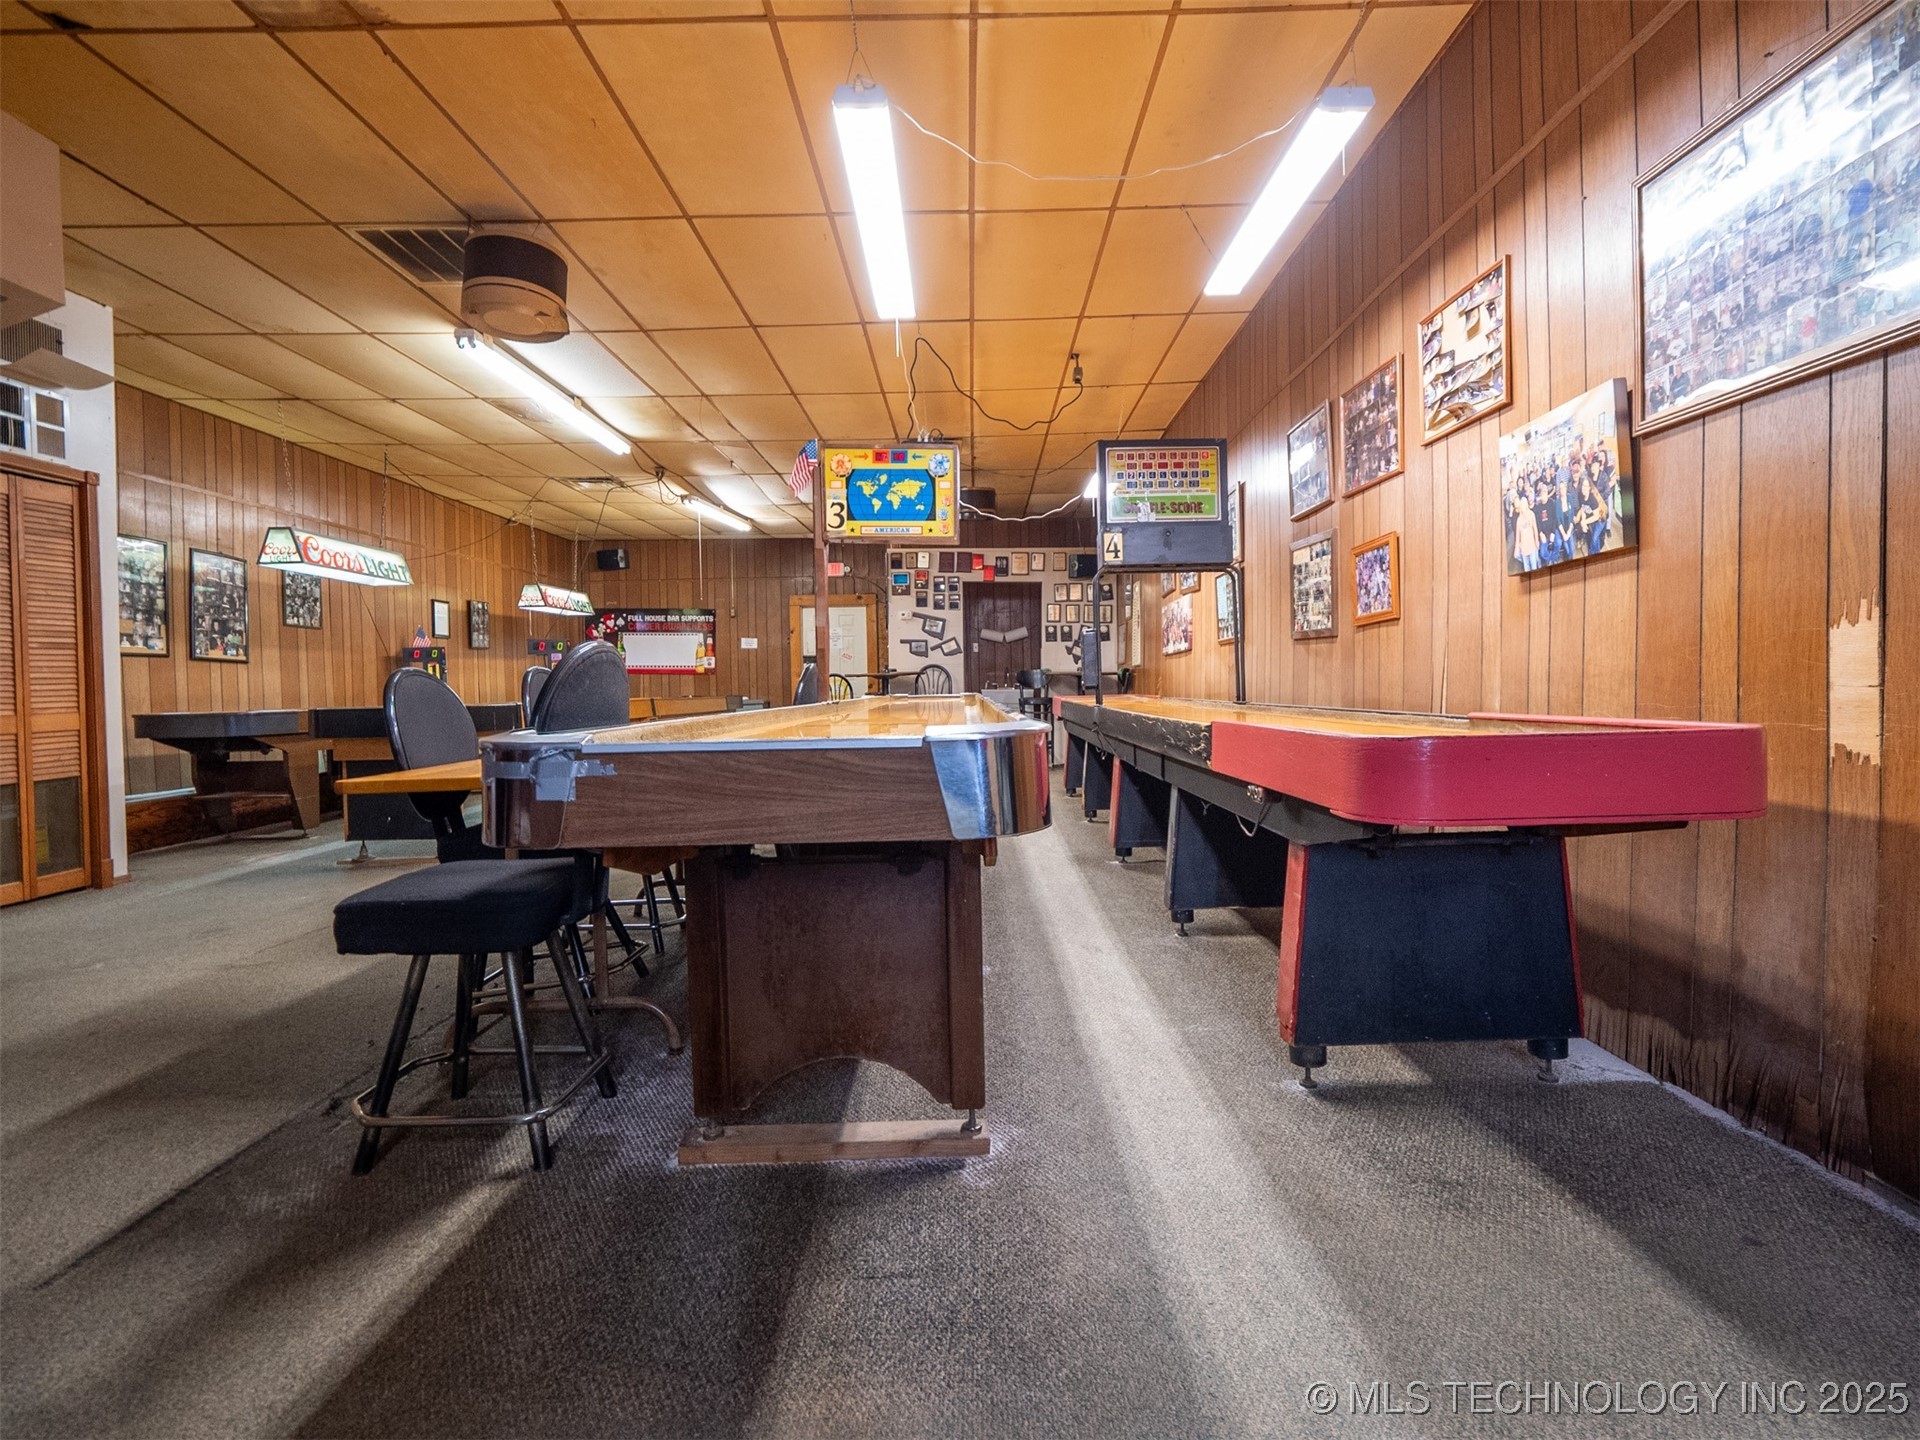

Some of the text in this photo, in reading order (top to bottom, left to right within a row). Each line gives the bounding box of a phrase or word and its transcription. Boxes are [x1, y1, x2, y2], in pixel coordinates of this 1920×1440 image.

[828, 502, 845, 529] 3
[262, 542, 298, 556] Coors
[1106, 534, 1120, 559] 4
[270, 555, 292, 563] LIGHT
[296, 535, 408, 581] Coors LIGHT
[662, 622, 713, 630] AWARENESS
[538, 642, 546, 650] 0
[557, 642, 564, 650] 0
[413, 650, 421, 658] 0
[432, 650, 438, 658] 0
